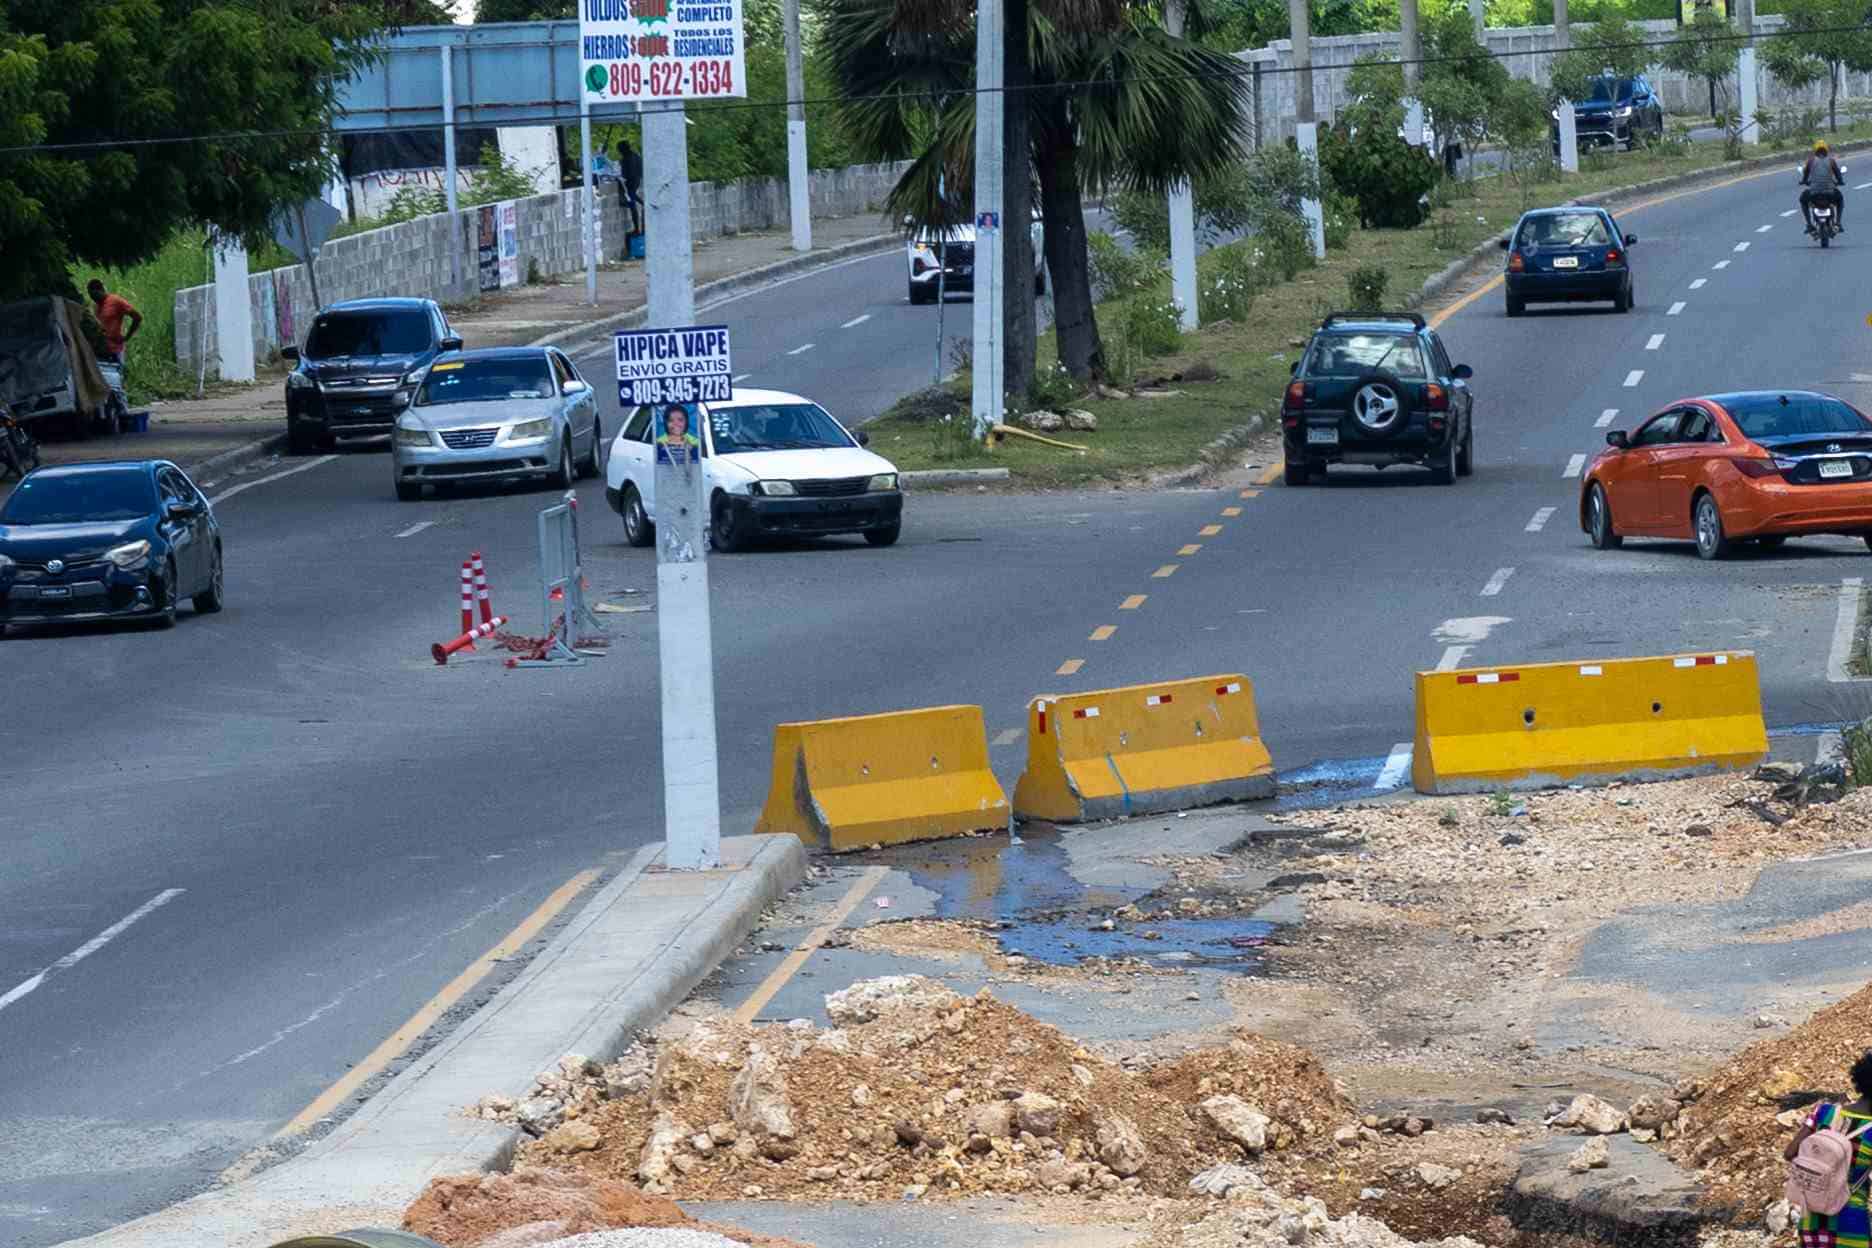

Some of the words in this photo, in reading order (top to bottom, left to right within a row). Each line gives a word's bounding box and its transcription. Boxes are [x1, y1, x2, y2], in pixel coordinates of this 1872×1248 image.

[677, 6, 732, 23] COMPLETO
[674, 29, 710, 38] TODOS
[713, 28, 733, 37] LOS
[584, 34, 629, 60] HIERROS
[674, 38, 735, 58] RESIDENCIALES
[610, 60, 732, 96] 809-622-1334
[617, 334, 680, 362] HIPICA
[682, 331, 727, 357] VAPE
[671, 359, 728, 374] GRATIS
[633, 375, 729, 404] 809-345-7273
